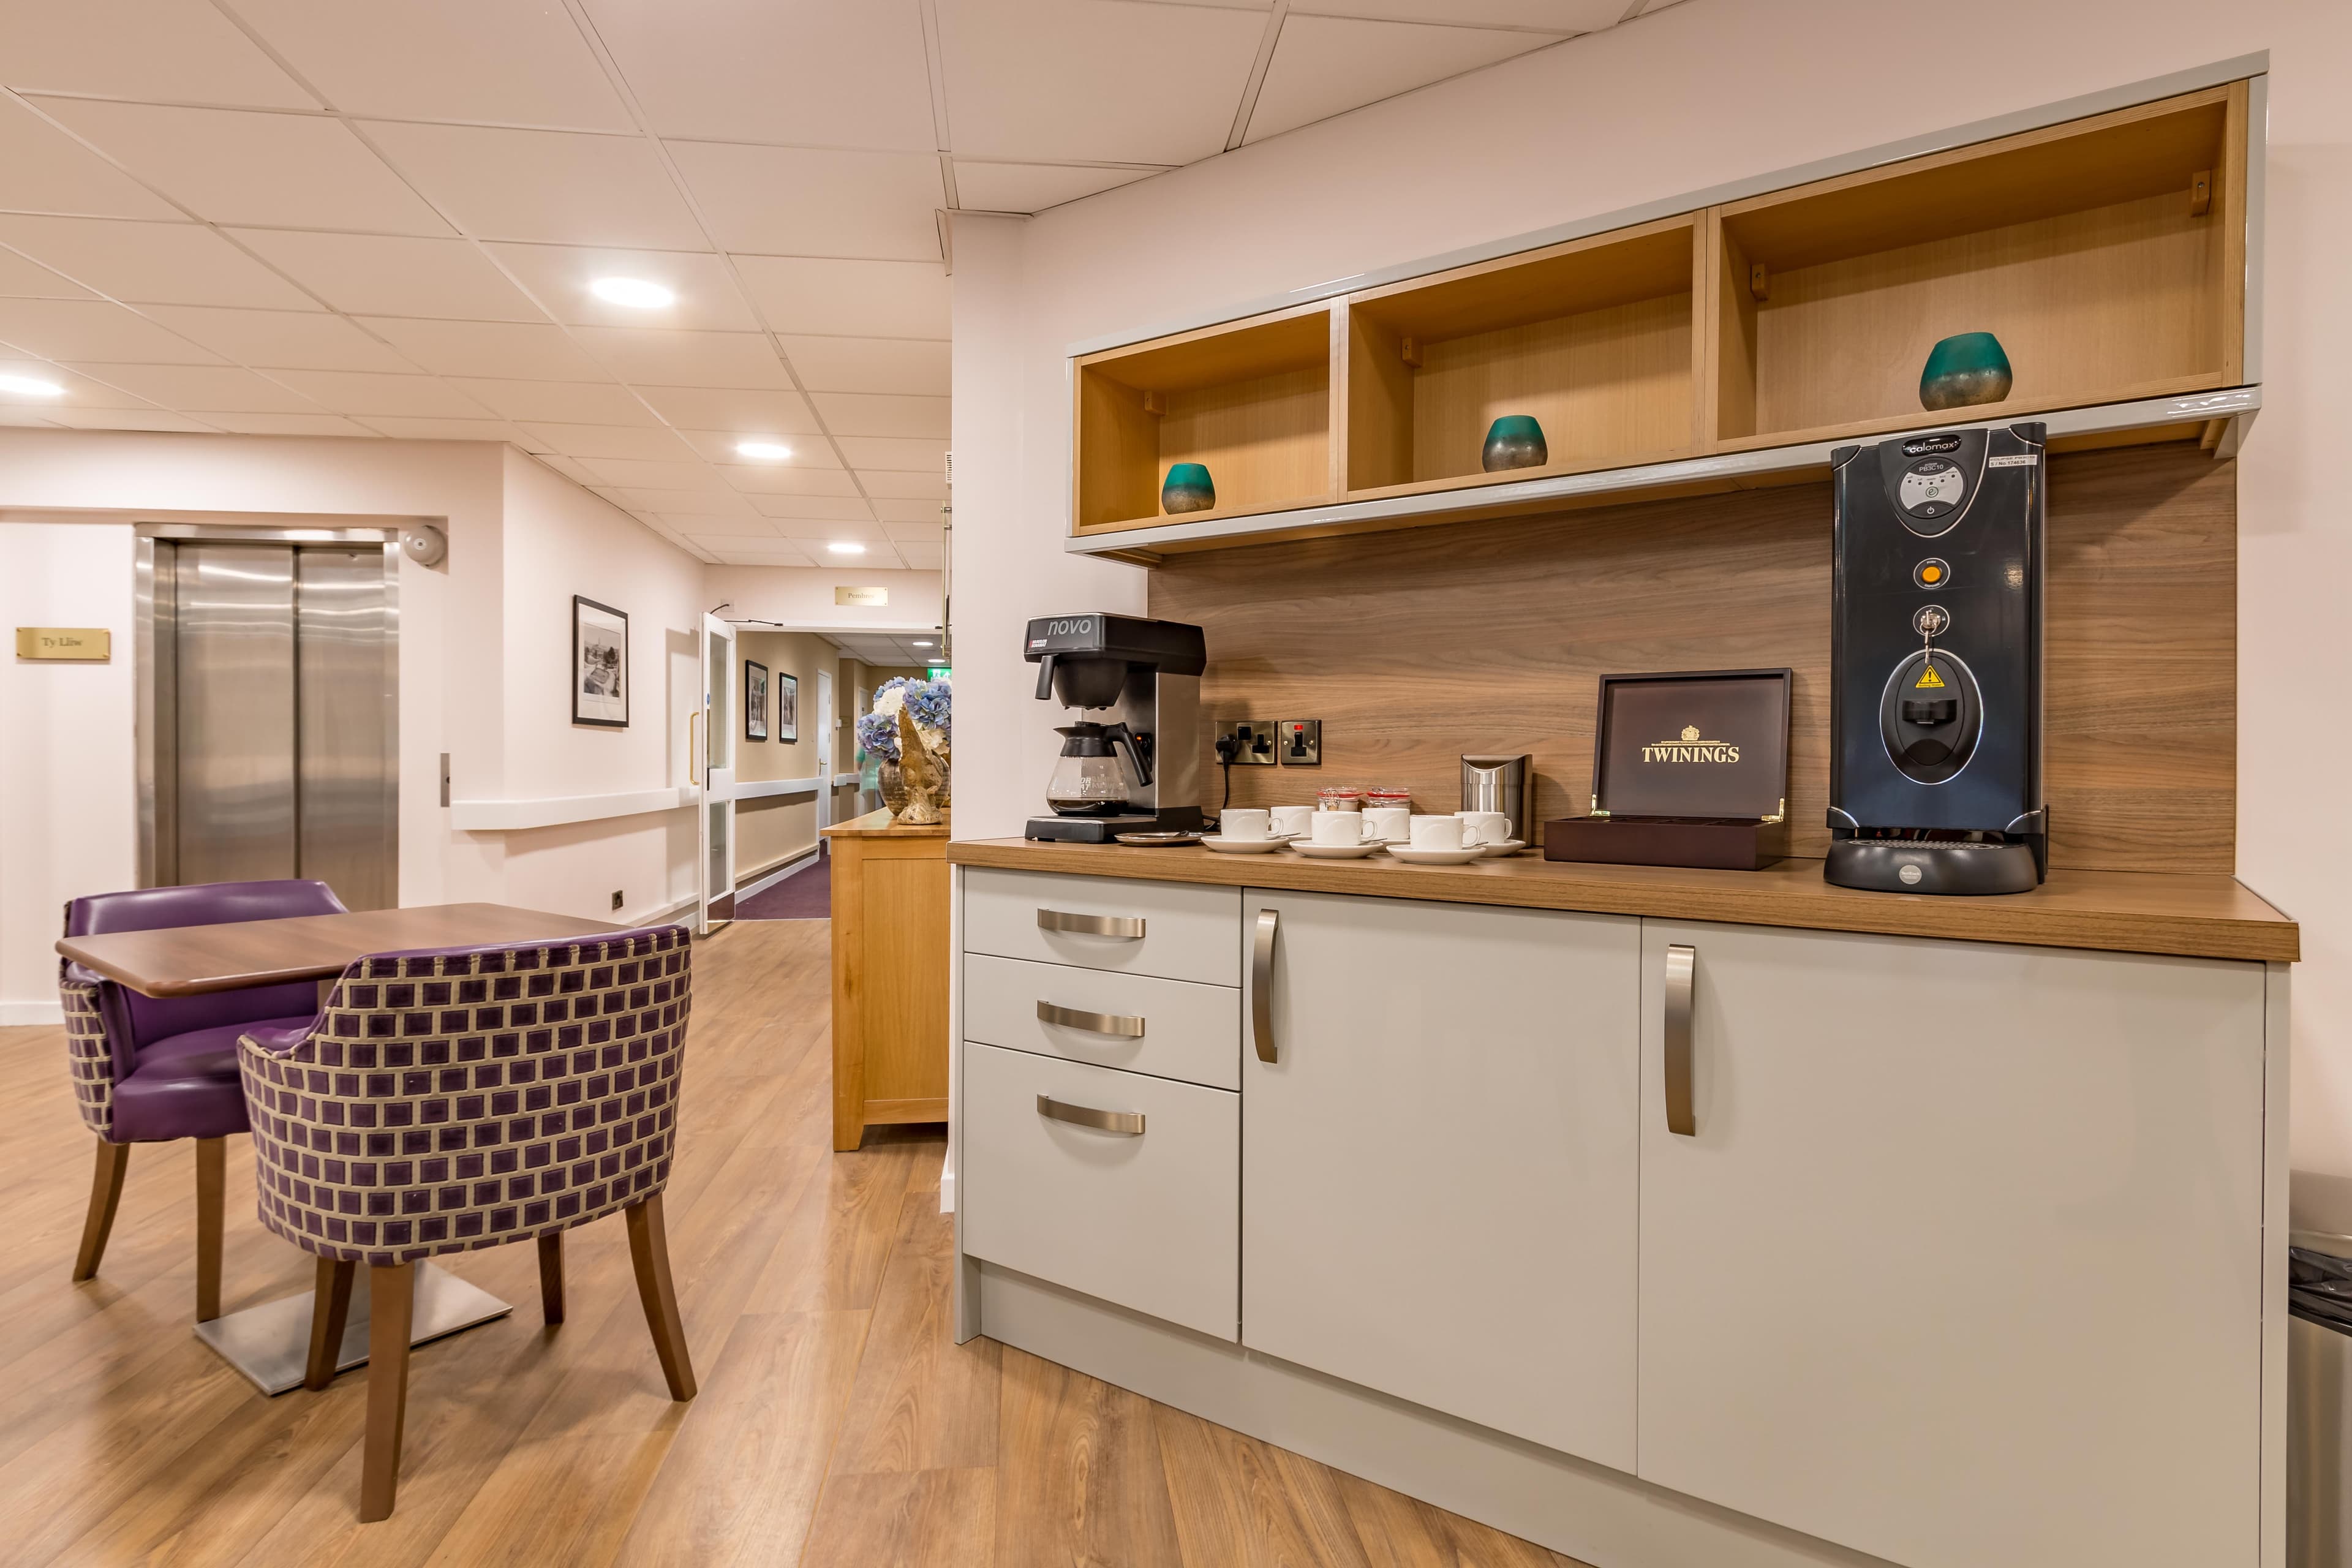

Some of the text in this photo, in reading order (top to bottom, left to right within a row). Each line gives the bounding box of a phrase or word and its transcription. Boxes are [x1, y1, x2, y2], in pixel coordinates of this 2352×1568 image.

[1910, 442, 1954, 453] calomax
[1047, 619, 1091, 636] novo
[41, 637, 56, 648] Ty
[1642, 747, 1740, 763] TWININGS
